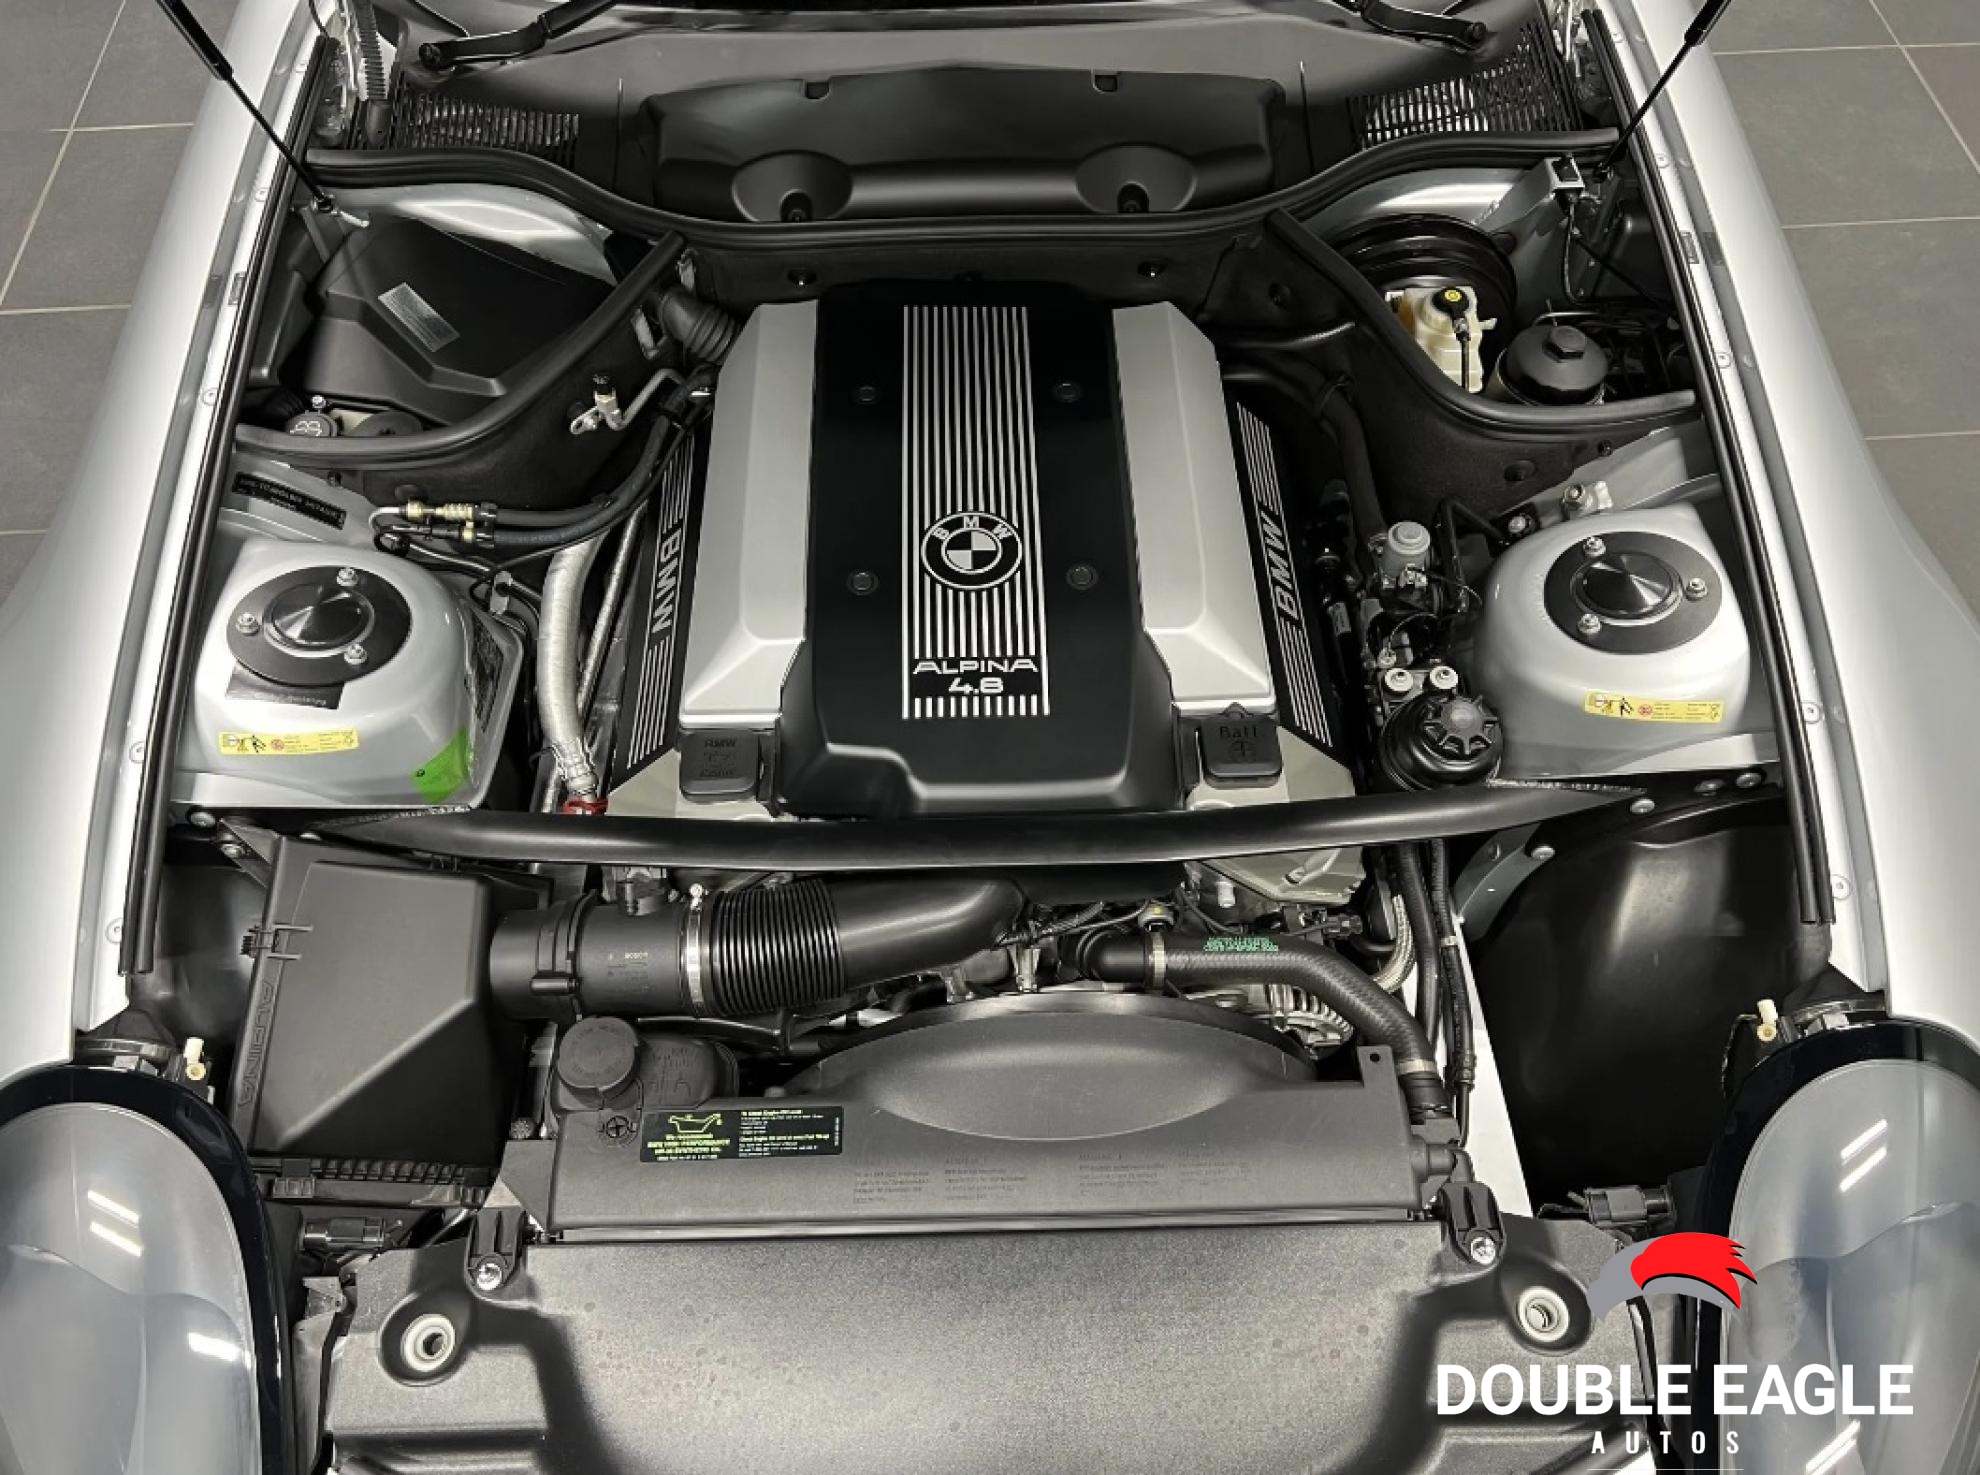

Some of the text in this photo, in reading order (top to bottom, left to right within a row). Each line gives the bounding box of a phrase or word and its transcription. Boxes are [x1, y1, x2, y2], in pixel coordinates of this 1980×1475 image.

[932, 515, 1013, 540] BMW
[652, 527, 682, 634] BMW
[1260, 510, 1300, 622] BMW
[912, 658, 1039, 675] ALPINA
[948, 676, 1004, 694] 4.8
[238, 980, 274, 1107] ALPINA
